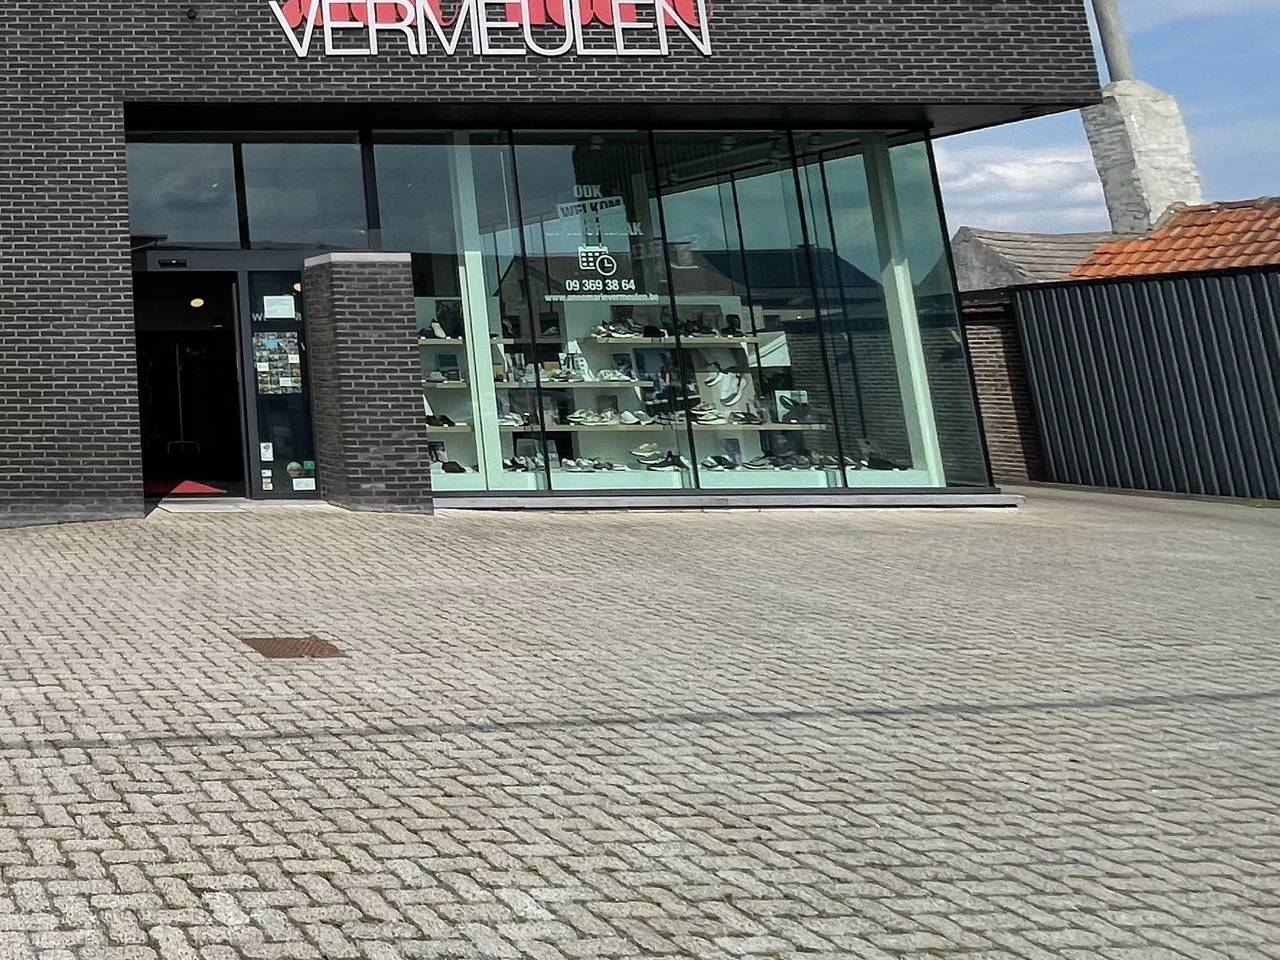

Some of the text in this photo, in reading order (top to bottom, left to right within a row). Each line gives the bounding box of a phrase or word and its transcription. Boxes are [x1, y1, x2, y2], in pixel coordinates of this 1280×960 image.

[574, 184, 603, 198] OOK
[565, 279, 636, 291] 09 369 38 64
